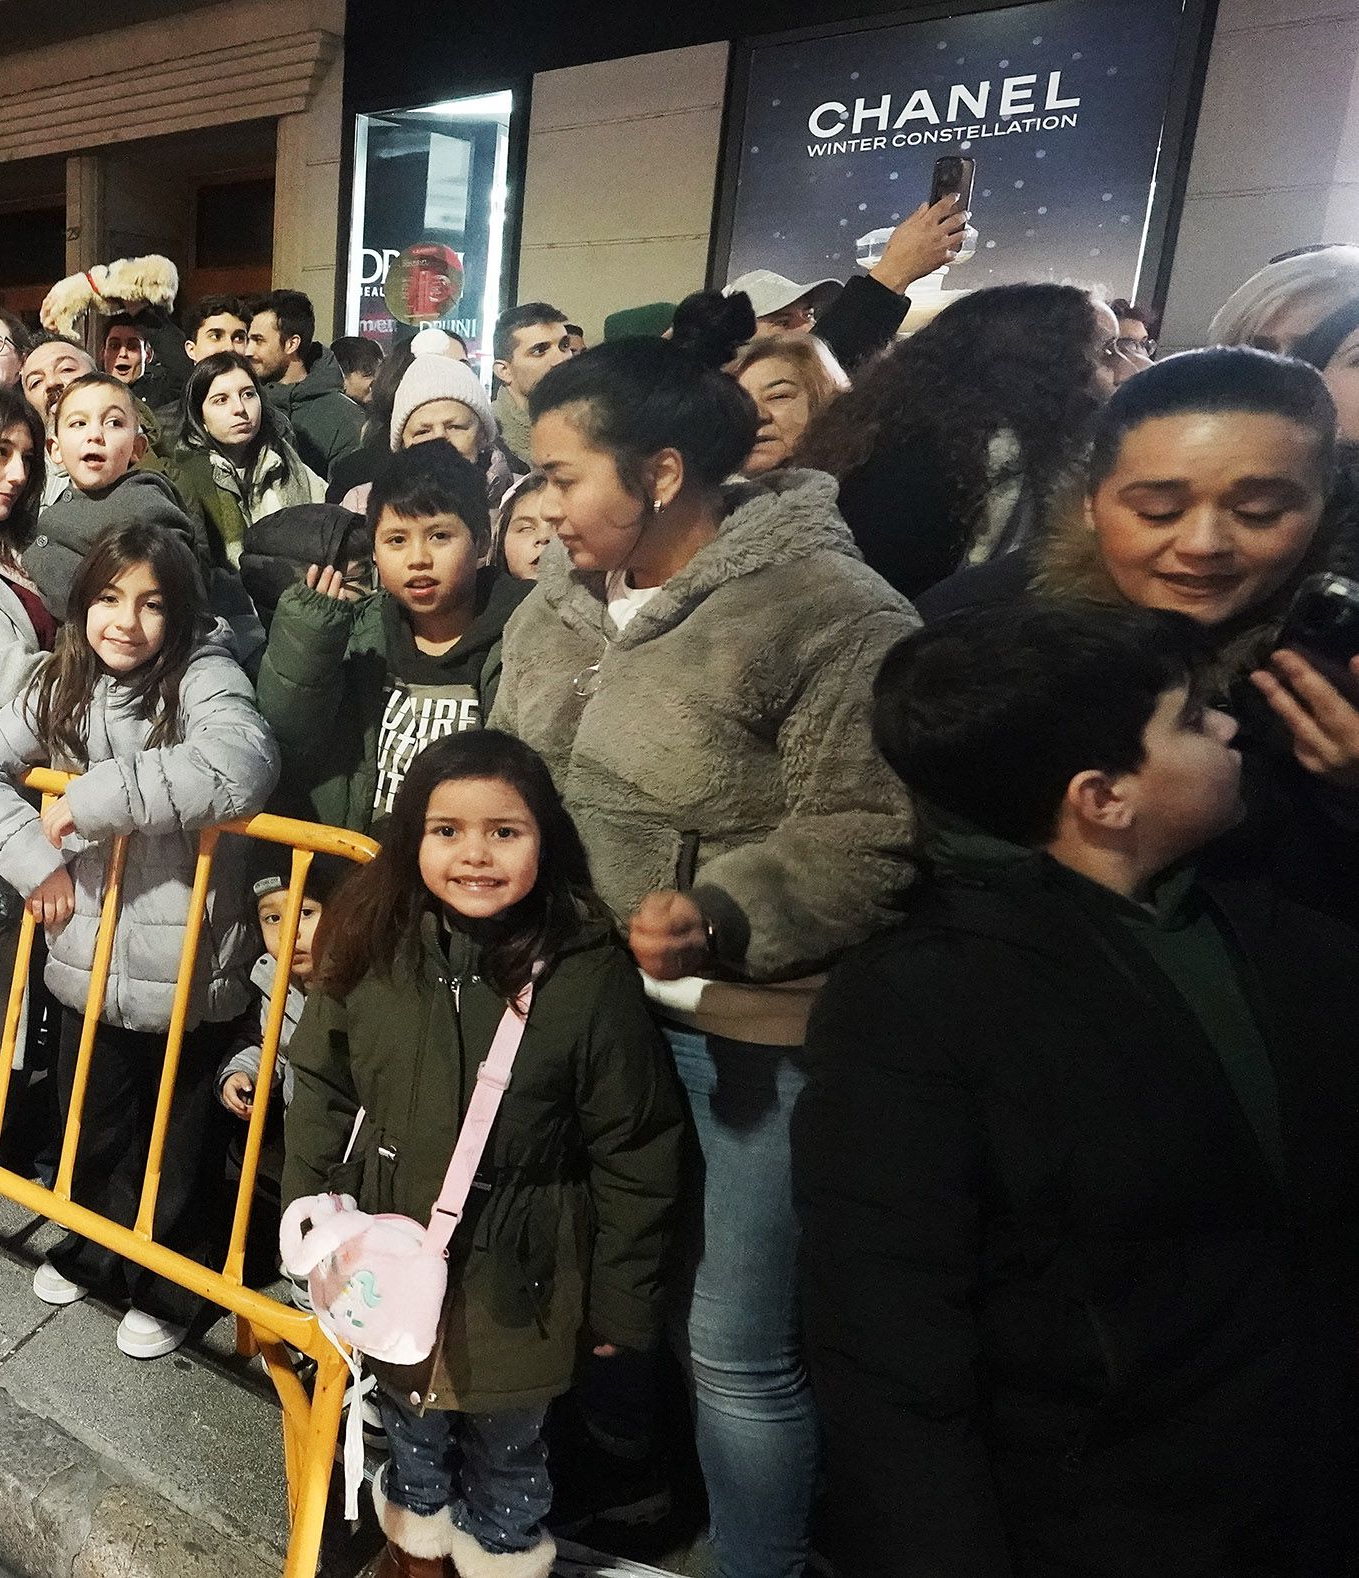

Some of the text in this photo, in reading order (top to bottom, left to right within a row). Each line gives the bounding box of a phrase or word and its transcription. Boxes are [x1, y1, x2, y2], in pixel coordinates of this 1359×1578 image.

[808, 70, 1082, 140] CHANEL
[806, 112, 1078, 159] WINTER CONSTELLATION
